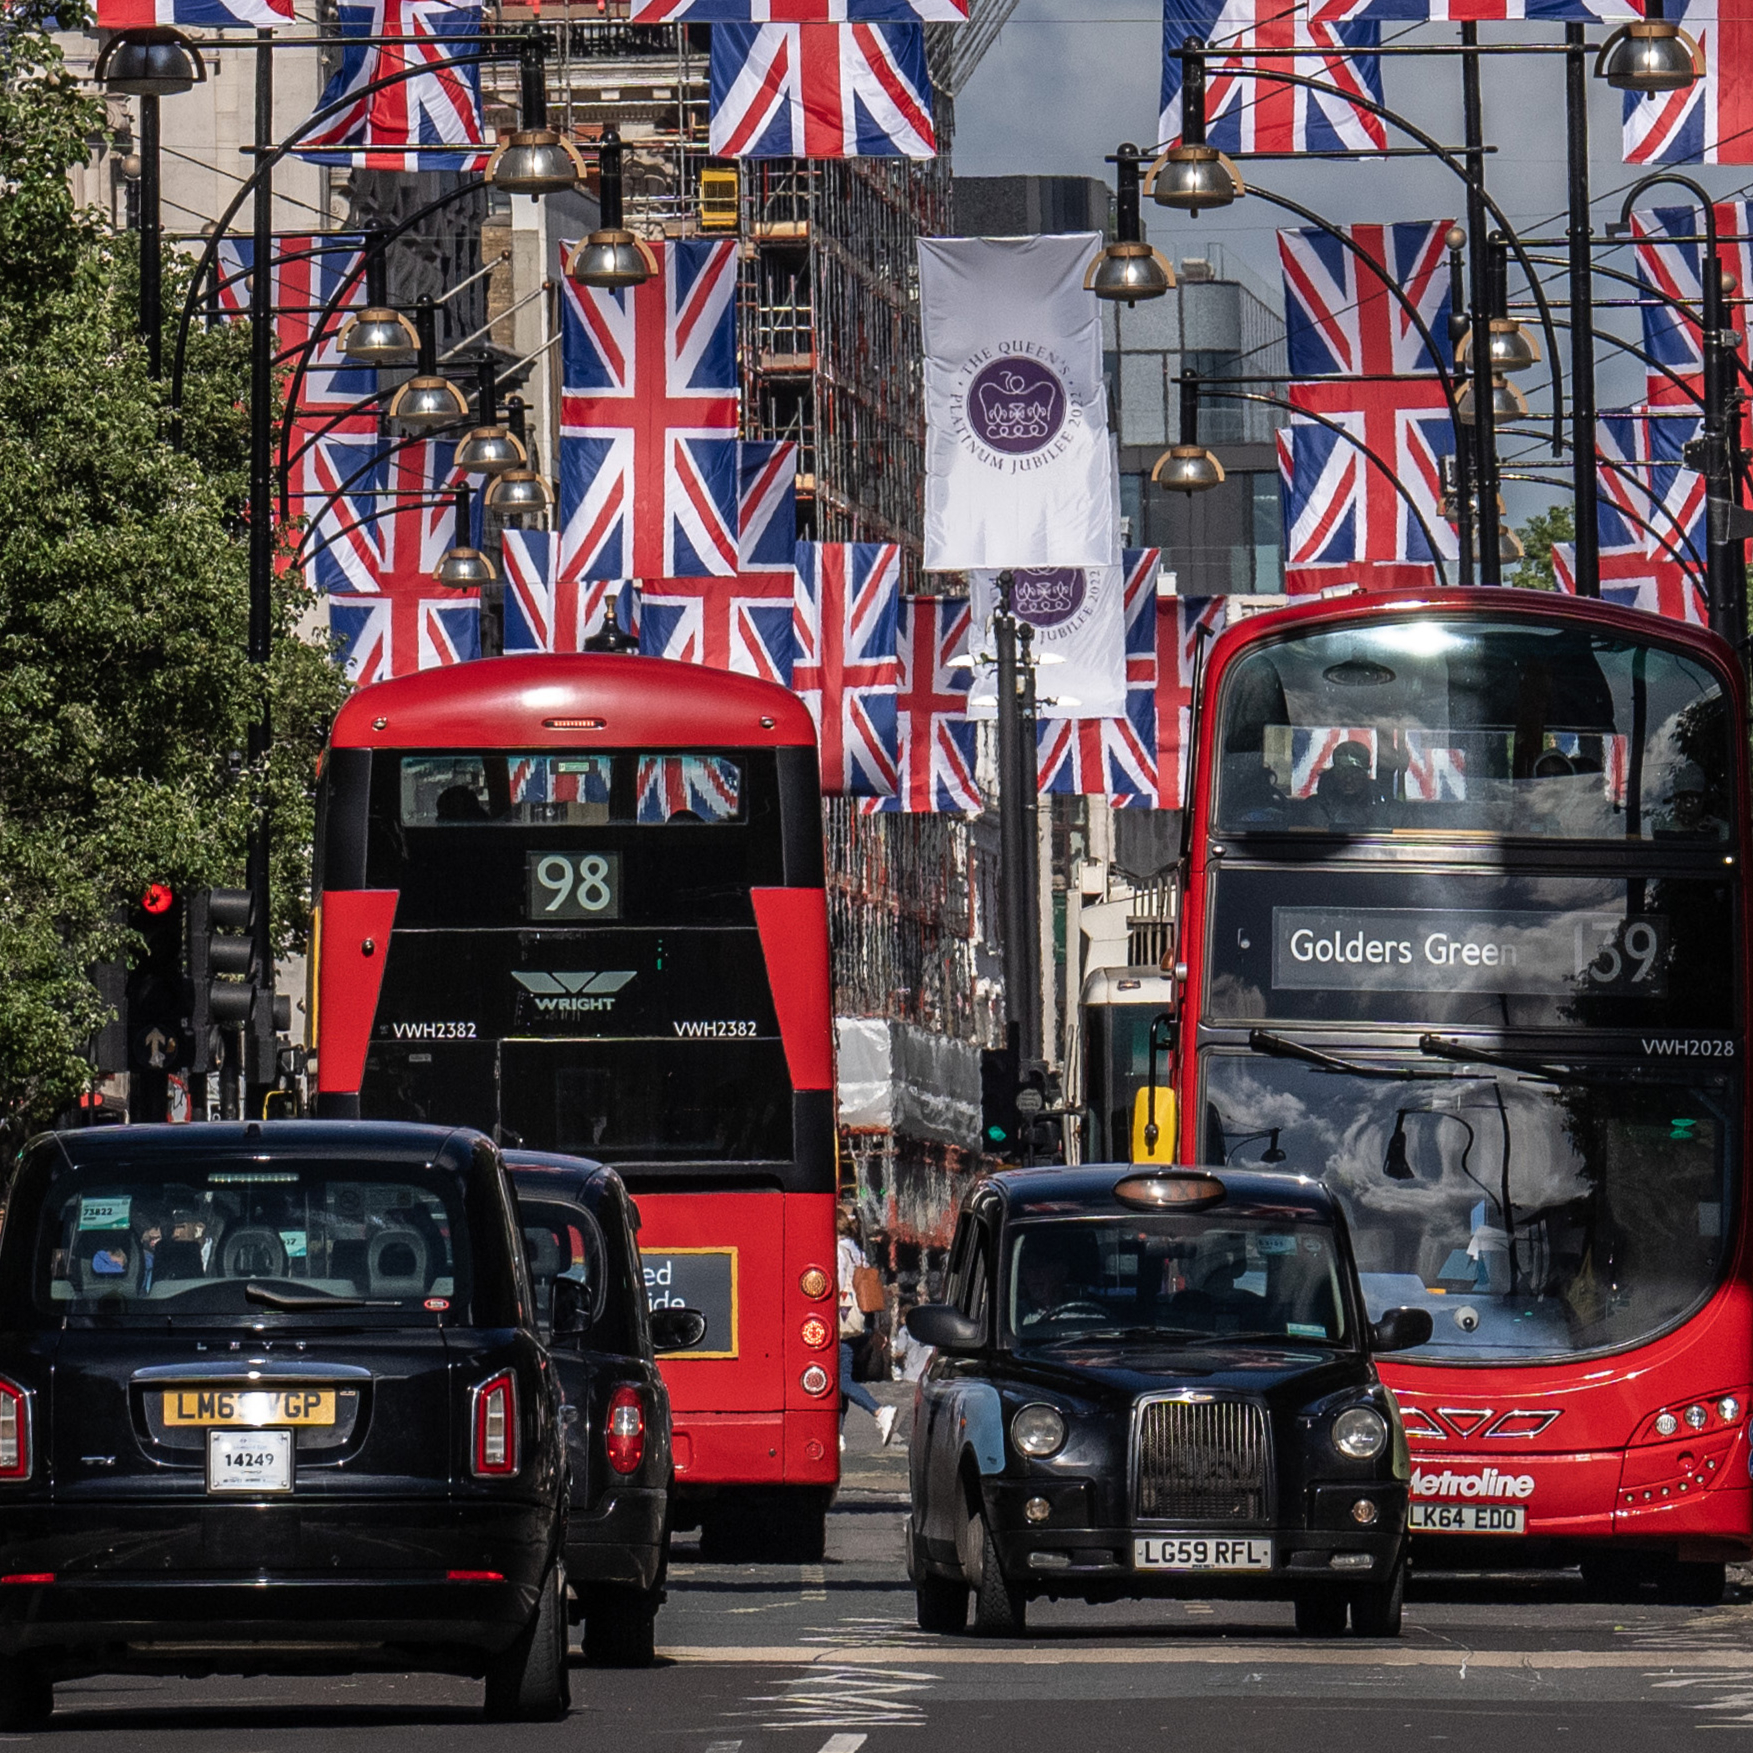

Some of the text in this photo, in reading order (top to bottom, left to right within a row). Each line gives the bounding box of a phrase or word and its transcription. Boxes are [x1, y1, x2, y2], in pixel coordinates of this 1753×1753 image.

[960, 340, 1071, 376] THE QUEEN'S
[949, 391, 1083, 475] PLATINUM JUBILEE 2022
[1039, 570, 1101, 645] JUBILEE 2022
[536, 854, 612, 912] 98
[1290, 928, 1517, 967] Golders Green
[1573, 920, 1658, 984] 139
[534, 997, 615, 1012] WRIGHT
[393, 1022, 478, 1039] VWH2382
[674, 1021, 758, 1038] VWH2382
[1642, 1038, 1735, 1057] VWH2028
[224, 1453, 275, 1467] 14249
[1410, 1505, 1517, 1530] LK64 EDO
[1144, 1540, 1262, 1565] LG59 RFL
